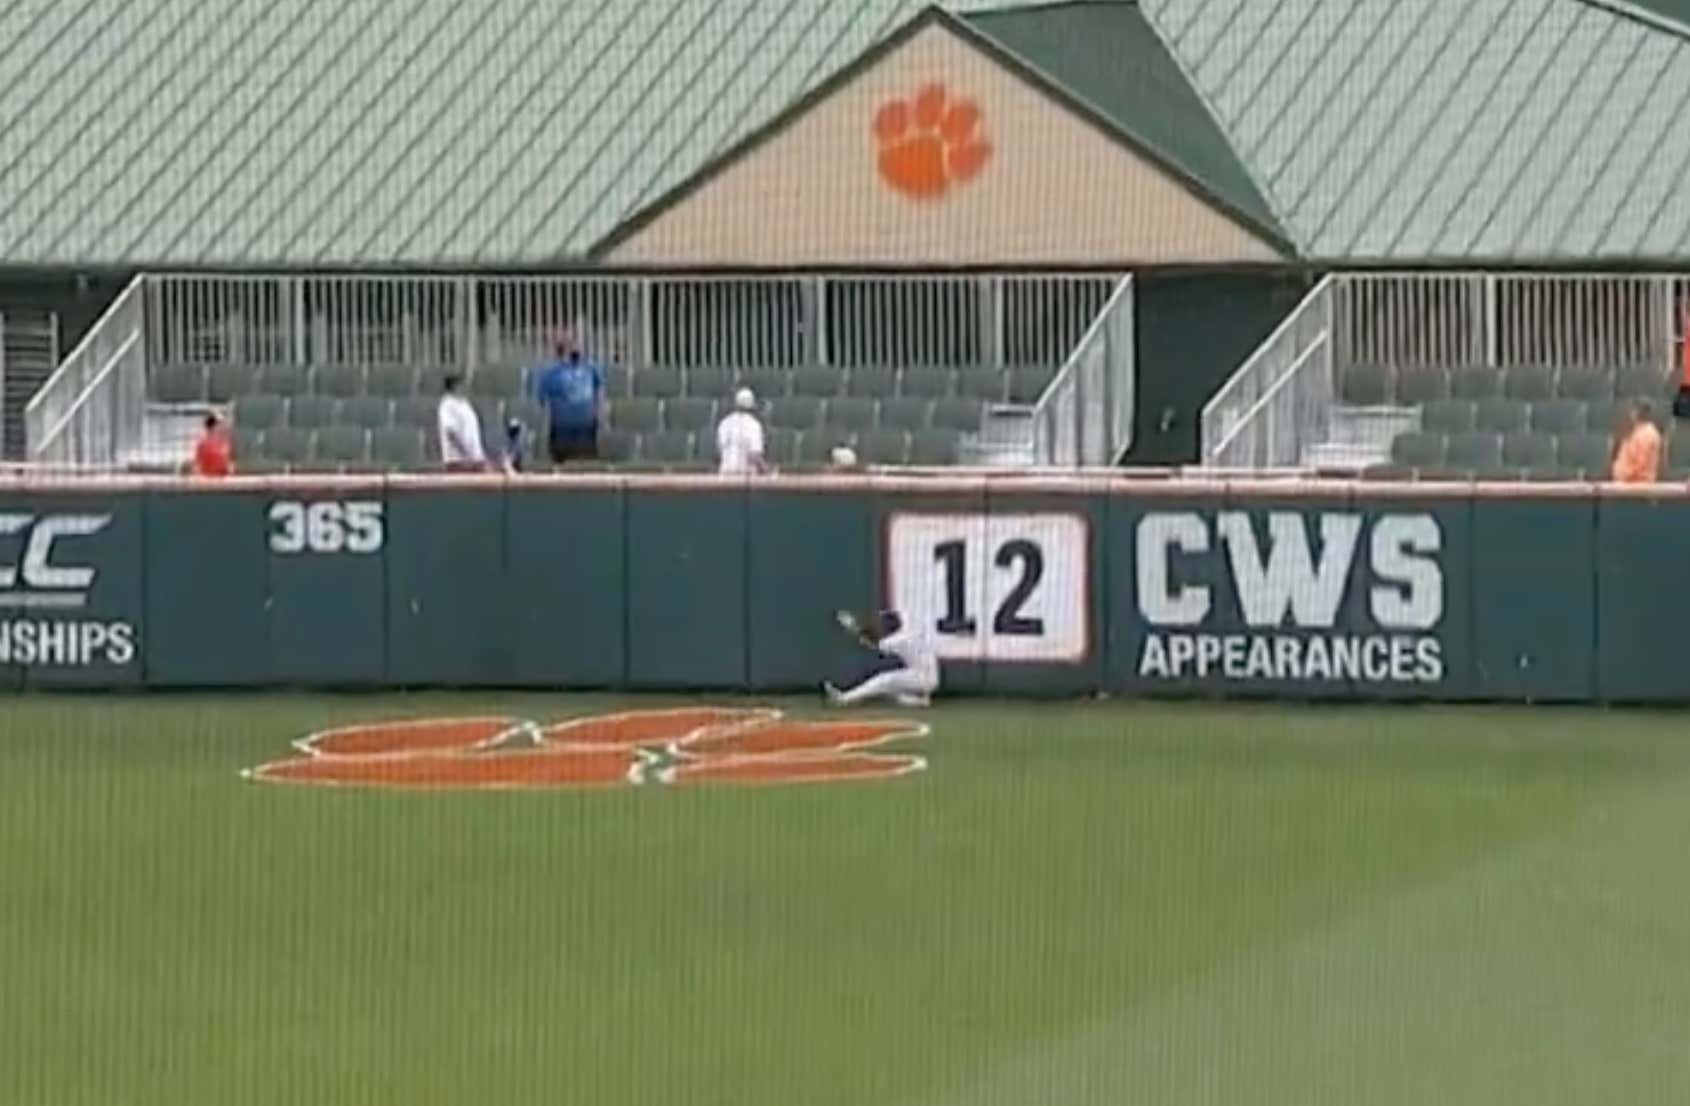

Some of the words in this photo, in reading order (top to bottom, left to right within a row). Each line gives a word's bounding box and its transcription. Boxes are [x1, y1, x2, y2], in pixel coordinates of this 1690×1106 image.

[268, 501, 384, 553] 365
[933, 540, 1046, 637] 12
[1136, 511, 1443, 629] CWS
[1139, 634, 1443, 682] APPEARANCES
